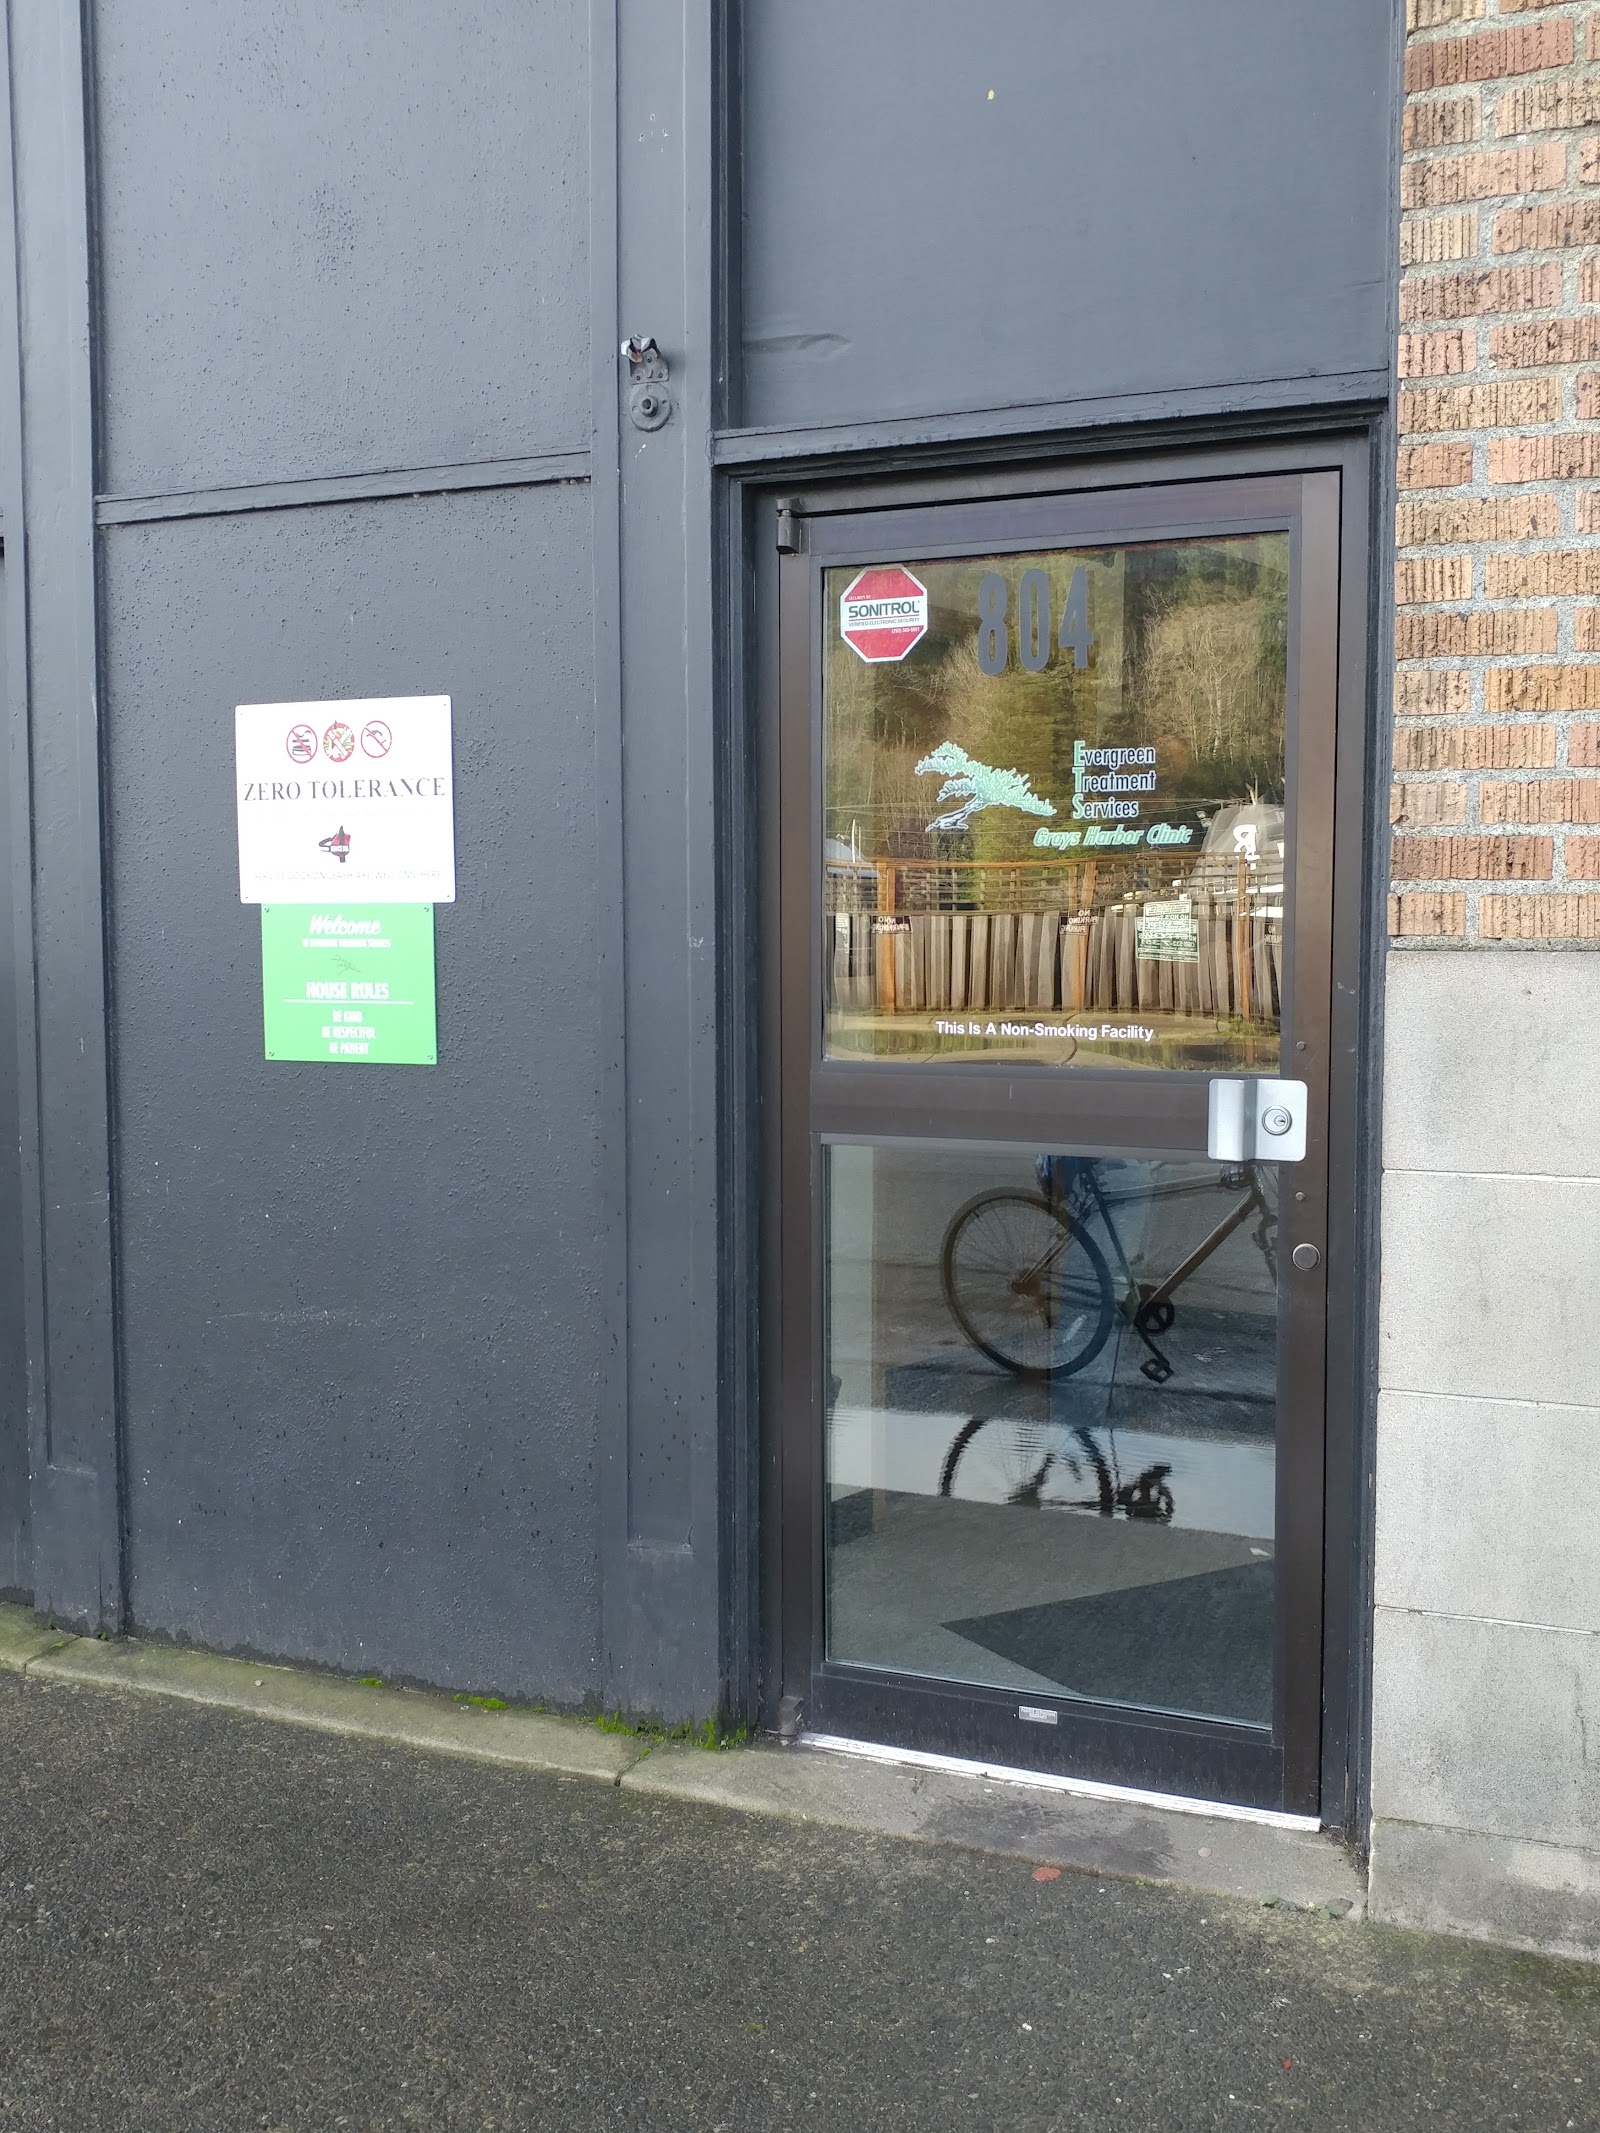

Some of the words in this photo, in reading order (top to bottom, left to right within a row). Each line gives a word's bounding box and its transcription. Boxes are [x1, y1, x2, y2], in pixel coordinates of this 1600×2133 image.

[848, 600, 920, 618] SONITROL
[977, 565, 1095, 676] 804
[1073, 740, 1156, 770] Evergreen
[244, 781, 301, 801] ZERO
[308, 777, 446, 799] TOLERANCE
[1072, 767, 1157, 793] Treatment
[1072, 794, 1140, 820] Services
[1033, 827, 1081, 851] Grays
[1083, 824, 1144, 847] Harbor
[1146, 822, 1194, 845] Clinic
[309, 913, 382, 935] Welcome
[306, 981, 348, 999] HOUSE
[350, 981, 390, 1000] RULES
[935, 1021, 965, 1035] This
[968, 1022, 981, 1035] Is
[985, 1022, 997, 1035] A
[1001, 1022, 1098, 1041] Non-Smoking
[1101, 1024, 1154, 1042] Facility
